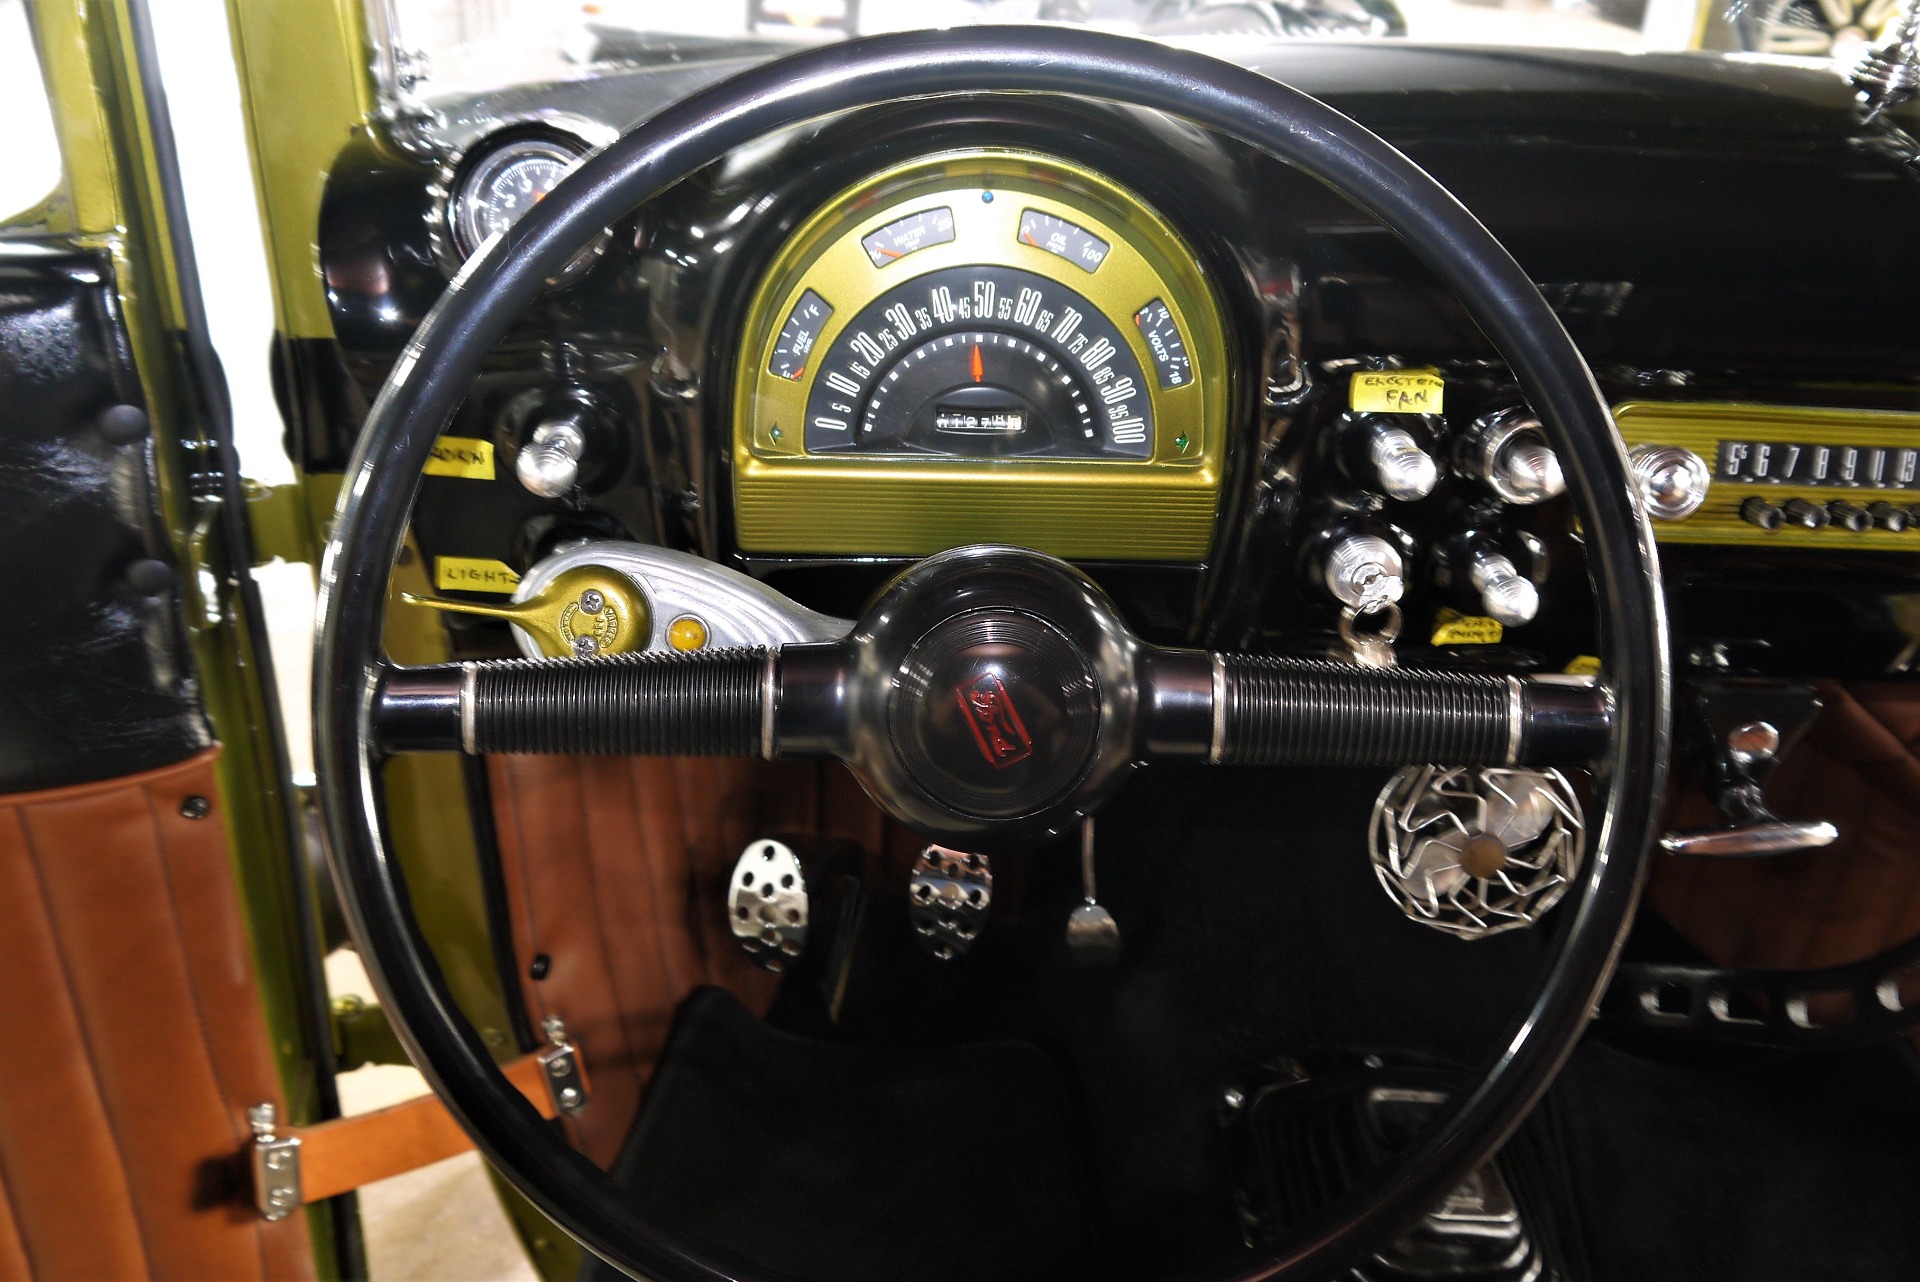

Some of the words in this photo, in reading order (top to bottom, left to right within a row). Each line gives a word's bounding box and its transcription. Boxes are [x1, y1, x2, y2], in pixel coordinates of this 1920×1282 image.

[505, 194, 516, 208] 2
[521, 180, 532, 193] 3
[893, 225, 926, 247] WATER
[1082, 247, 1103, 263] 100
[809, 304, 820, 317] F
[932, 286, 954, 324] 40
[958, 296, 971, 319] 45
[974, 281, 995, 318] 50
[998, 298, 1013, 320] 55
[1014, 288, 1042, 326] 60
[885, 303, 917, 340] 30
[915, 307, 932, 330] 35
[1035, 309, 1054, 332] 65
[1157, 306, 1170, 319] 10
[1051, 306, 1082, 343] 70
[792, 330, 810, 356] FUEL
[850, 332, 885, 366] 20
[878, 328, 898, 350] 25
[1068, 333, 1088, 354] 75
[1148, 329, 1169, 362] VOLTS
[1080, 338, 1116, 371] 80
[850, 362, 870, 379] 15
[1092, 366, 1116, 384] 85
[1169, 371, 1182, 385] 18
[826, 372, 860, 398] 10
[1101, 377, 1137, 405] 90
[832, 402, 851, 412] 5
[1386, 388, 1428, 410] FAN
[1108, 405, 1129, 419] 95
[815, 418, 847, 430] 0
[1112, 418, 1146, 443] 100
[1756, 446, 1771, 476] 6
[1786, 447, 1800, 478] 7
[1815, 449, 1829, 479] 8
[1843, 450, 1858, 480] 9
[1871, 451, 1886, 481] 11
[1900, 451, 1917, 482] 13
